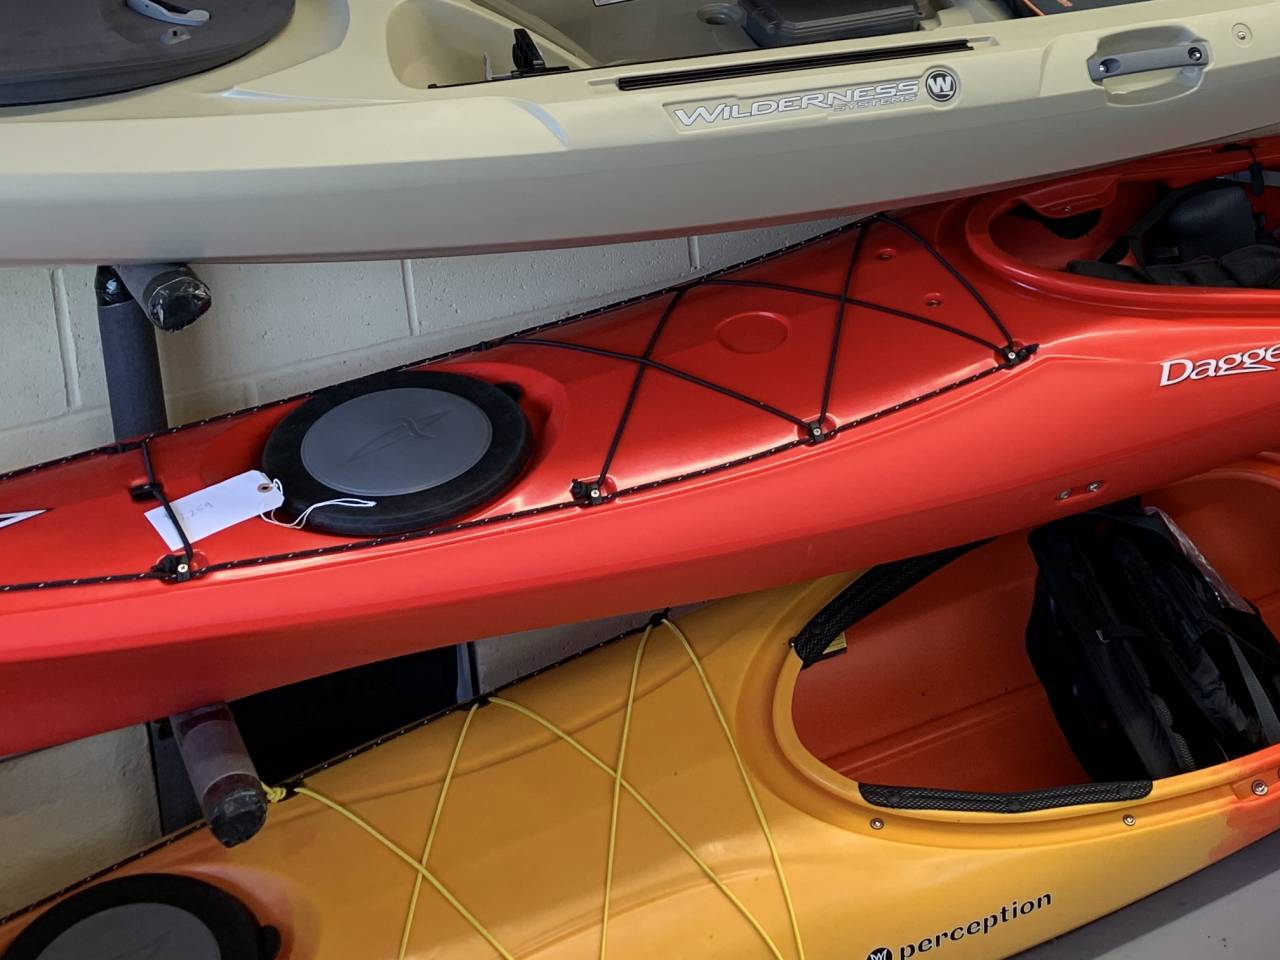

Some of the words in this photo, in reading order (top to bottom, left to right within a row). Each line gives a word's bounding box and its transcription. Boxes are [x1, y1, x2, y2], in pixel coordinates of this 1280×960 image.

[674, 80, 919, 126] WILDERNESS
[833, 94, 917, 112] SYSTEMS
[899, 893, 1051, 960] perception
